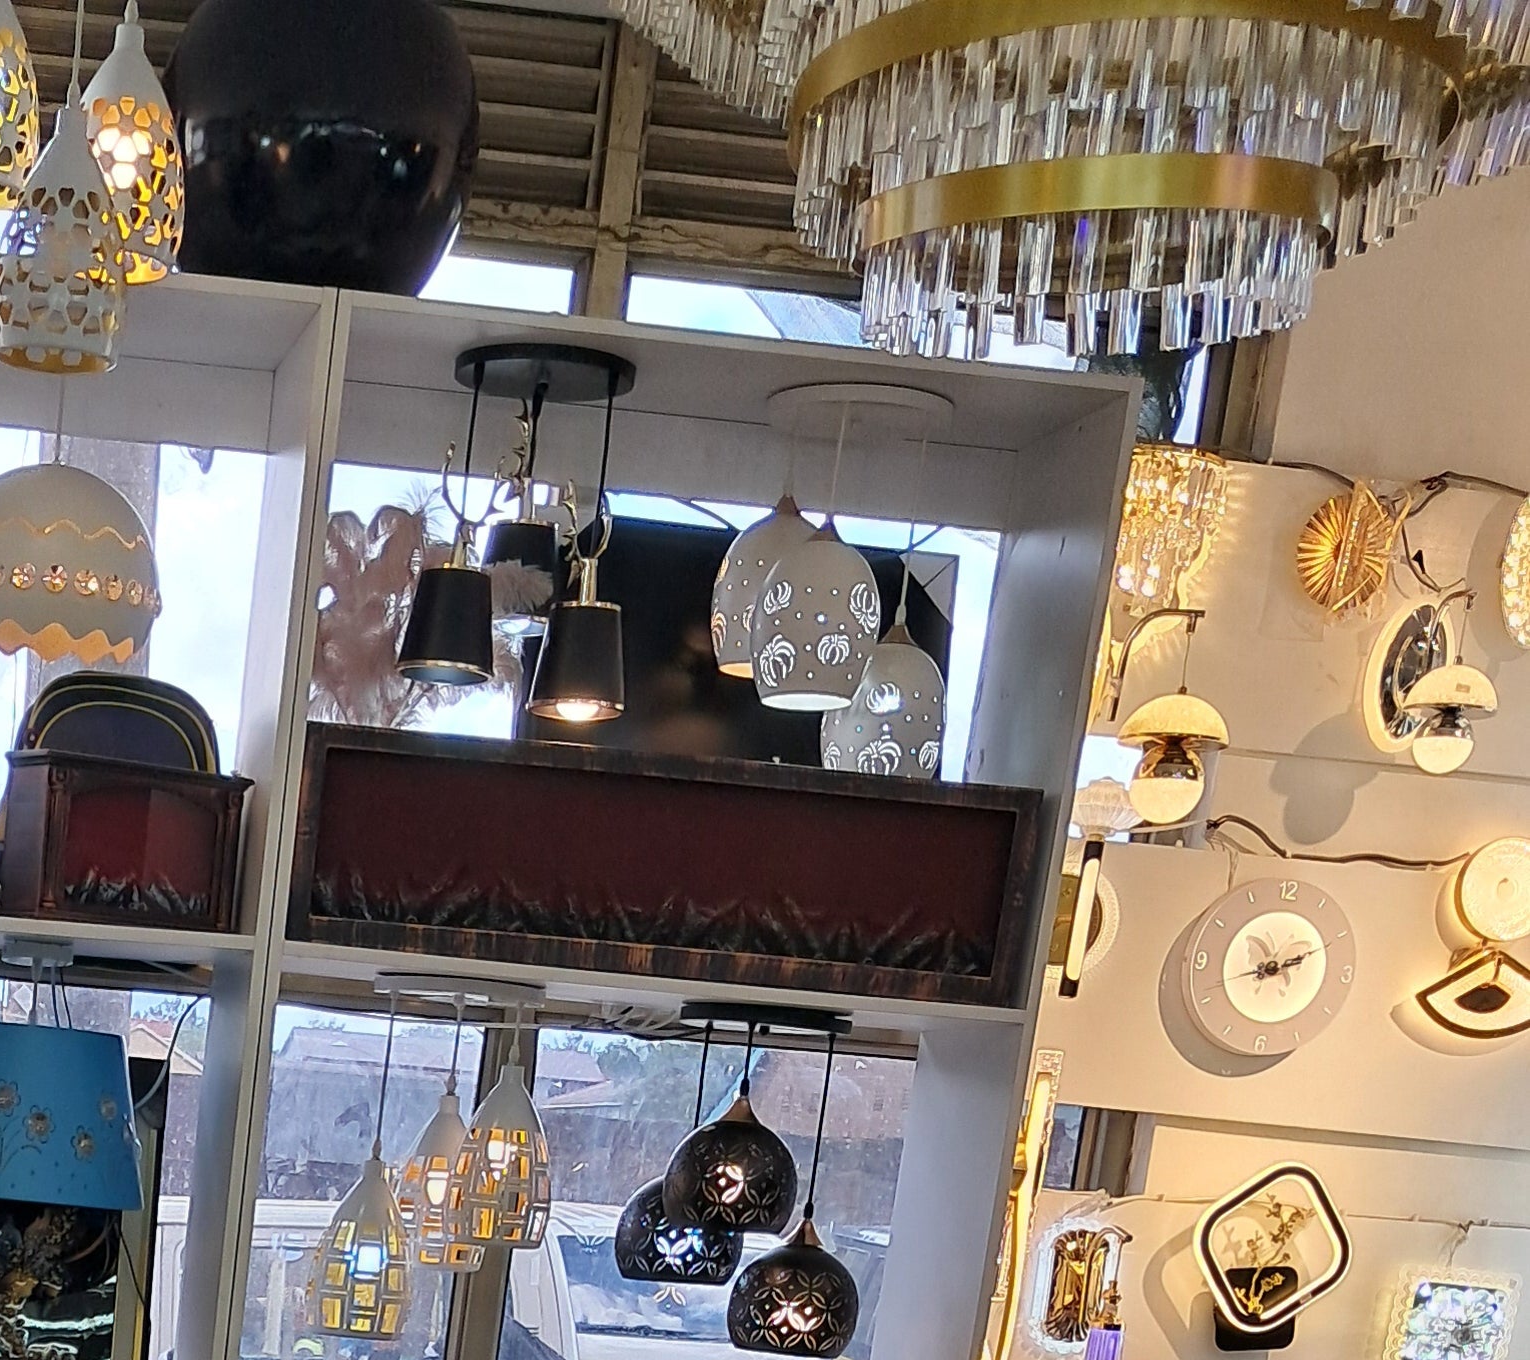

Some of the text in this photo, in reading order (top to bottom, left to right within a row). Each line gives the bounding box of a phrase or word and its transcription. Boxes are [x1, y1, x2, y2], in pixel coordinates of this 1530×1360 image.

[1279, 881, 1298, 901] 12
[1195, 951, 1208, 970] 9
[1340, 965, 1353, 984] 3
[1254, 1035, 1267, 1053] 6
